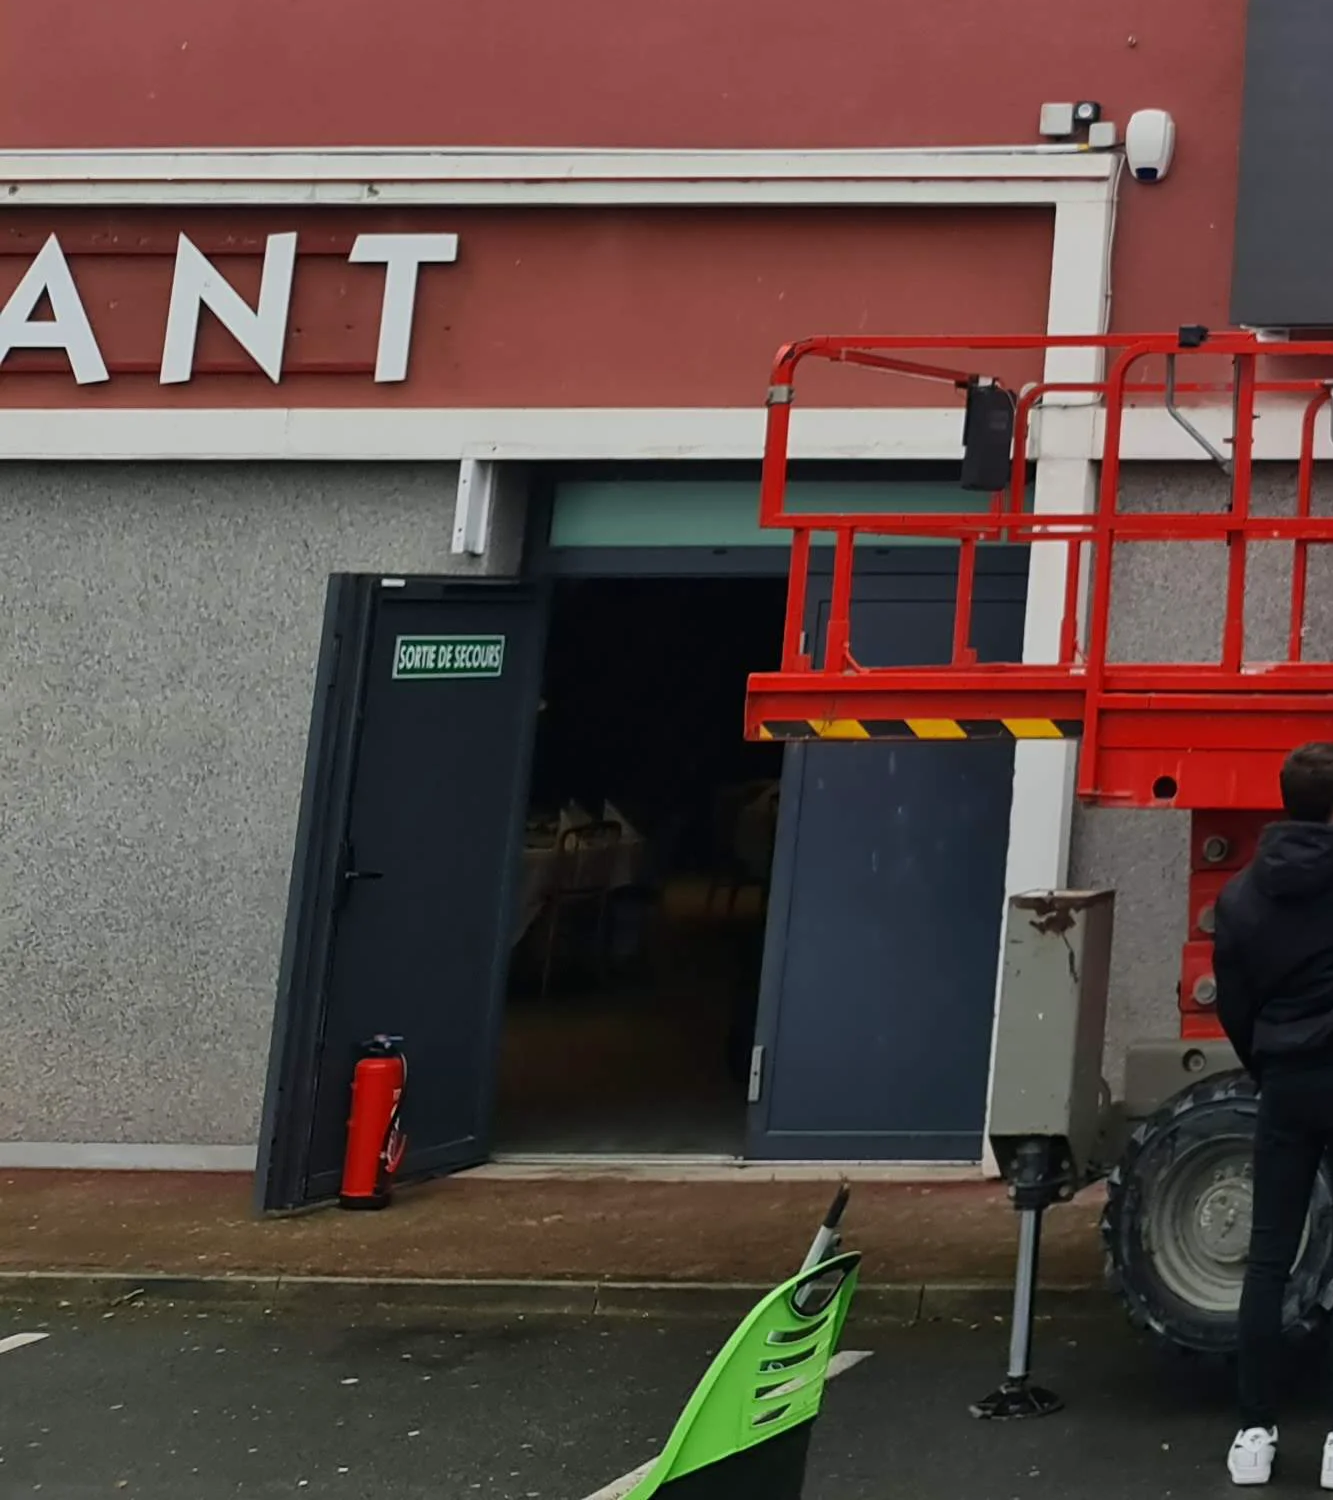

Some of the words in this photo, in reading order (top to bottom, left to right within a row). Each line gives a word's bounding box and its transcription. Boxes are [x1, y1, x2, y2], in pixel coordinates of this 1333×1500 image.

[0, 231, 458, 384] ANT
[399, 645, 437, 669] SORTIE
[437, 645, 453, 668] DE
[454, 644, 501, 668] SECOURS
